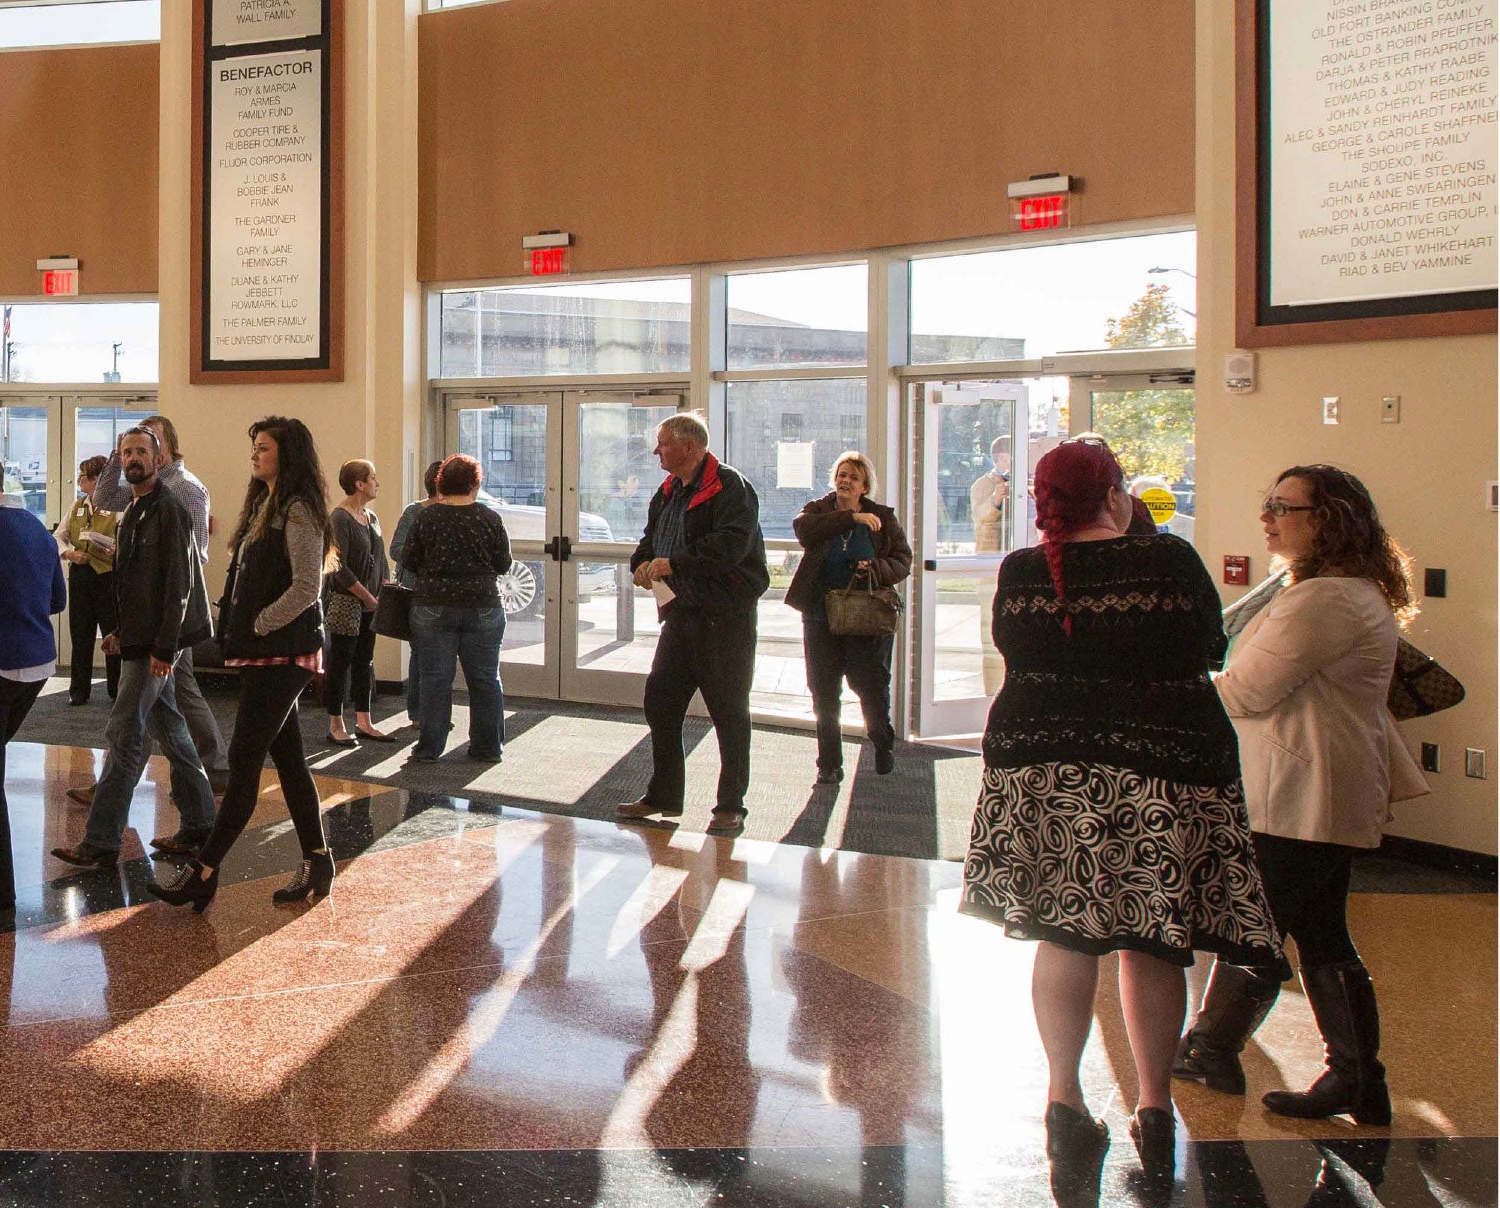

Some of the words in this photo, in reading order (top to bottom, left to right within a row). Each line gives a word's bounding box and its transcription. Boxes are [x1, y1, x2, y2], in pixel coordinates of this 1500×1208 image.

[236, 13, 262, 24] WALL
[264, 9, 295, 21] FAMILY
[1326, 3, 1366, 21] NISSIN
[1311, 24, 1335, 39] OLD
[1339, 17, 1369, 33] FORT
[1374, 6, 1432, 26] BANKING
[1330, 35, 1352, 50] THE
[1356, 16, 1433, 44] OSTRANDER
[1437, 5, 1483, 25] FAMILY
[1321, 46, 1370, 66] RONALD
[1375, 43, 1382, 54] &
[1386, 33, 1426, 52] ROBIN
[1431, 18, 1496, 42] PFEIFFER
[220, 62, 312, 82] BENEFACTOR
[1315, 64, 1354, 82] DARJA
[1359, 61, 1365, 72] &
[1369, 52, 1409, 70] PETER
[1329, 73, 1378, 93] THOMAS
[1383, 71, 1390, 82] &
[1394, 61, 1436, 80] KATHY
[1440, 51, 1485, 70] RAABE
[234, 86, 252, 96] ROY
[255, 86, 260, 94] &
[262, 82, 296, 94] MARCIA
[1324, 88, 1376, 108] EDWARD
[1380, 86, 1388, 97] &
[1393, 79, 1424, 95] JUDY
[1428, 66, 1490, 88] READING
[250, 96, 280, 107] ARMES
[1327, 106, 1359, 122] JOHN
[1363, 104, 1371, 115] &
[1375, 94, 1426, 113] CHERYL
[1430, 82, 1486, 102] REINEKE
[238, 109, 266, 120] FAMILY
[268, 107, 293, 117] FUND
[1284, 129, 1313, 144] ALEC
[1317, 127, 1324, 138] &
[1328, 119, 1369, 136] SANDY
[1372, 105, 1446, 128] REINHARDT
[1450, 96, 1497, 114] FAMILY
[233, 127, 269, 138] COOPER
[272, 125, 290, 135] TIRE
[292, 124, 298, 133] &
[1312, 135, 1362, 153] GEORGE
[1366, 133, 1373, 144] &
[1378, 123, 1429, 142] CAROLE
[1433, 111, 1498, 132] SHAFFNE
[225, 140, 260, 151] RUBBER
[262, 136, 305, 148] COMPANY
[1342, 148, 1364, 162] THE
[1369, 140, 1420, 158] SHOUPE
[1425, 132, 1469, 149] FAMILY
[219, 158, 247, 168] FLUOR
[249, 152, 311, 166] CORPORATION
[253, 173, 278, 183] LOUIS
[280, 172, 286, 181] &
[1328, 177, 1369, 193] ELAINE
[1374, 175, 1381, 186] &
[1386, 169, 1420, 184] GENE
[1425, 160, 1485, 178] STEVENS
[236, 186, 268, 197] BOBBIE
[271, 184, 293, 194] JEAN
[1320, 194, 1352, 208] JOHN
[1356, 192, 1364, 203] &
[1368, 187, 1402, 201] ANNE
[1406, 173, 1496, 196] SWEARINGEN
[250, 197, 279, 207] FRANK
[1331, 208, 1358, 221] DON
[1362, 206, 1369, 217] &
[1373, 199, 1420, 215] CARRIE
[1426, 191, 1481, 208] TEMPLIN
[235, 217, 250, 226] THE
[253, 214, 295, 225] GARDNER
[1021, 196, 1062, 230] EXIT
[250, 228, 278, 237] FAMILY
[1298, 223, 1349, 239] WARNER
[1353, 213, 1434, 232] AUTOMOTIVE
[1350, 232, 1402, 248] DONALD
[1406, 225, 1459, 241] WEHRLY
[236, 246, 260, 256] GARY
[262, 246, 268, 254] &
[271, 244, 292, 254] JANE
[1321, 252, 1355, 266] DAVID
[1360, 250, 1367, 261] &
[1373, 246, 1411, 260] JANET
[1415, 236, 1496, 255] WHIKEHART
[241, 257, 287, 268] HEMINGER
[532, 249, 564, 275] EXIT
[1339, 265, 1367, 278] RIAD
[1372, 264, 1379, 274] &
[1383, 261, 1408, 273] BEV
[1412, 254, 1471, 270] YAMMINE
[44, 272, 72, 294] EXIT
[230, 276, 260, 286] DUANE
[262, 276, 268, 284] &
[270, 274, 298, 284] KATHY
[246, 287, 281, 298] JEBBETT
[281, 299, 298, 308] LLC
[223, 319, 238, 328] THE
[241, 318, 275, 327] PALMER
[277, 316, 306, 326] FAMILY
[216, 336, 229, 345] THE
[230, 336, 271, 345] UNIVERSITY
[272, 335, 283, 344] OF
[284, 335, 313, 344] FINDLAY
[1147, 502, 1175, 510] AUTION
